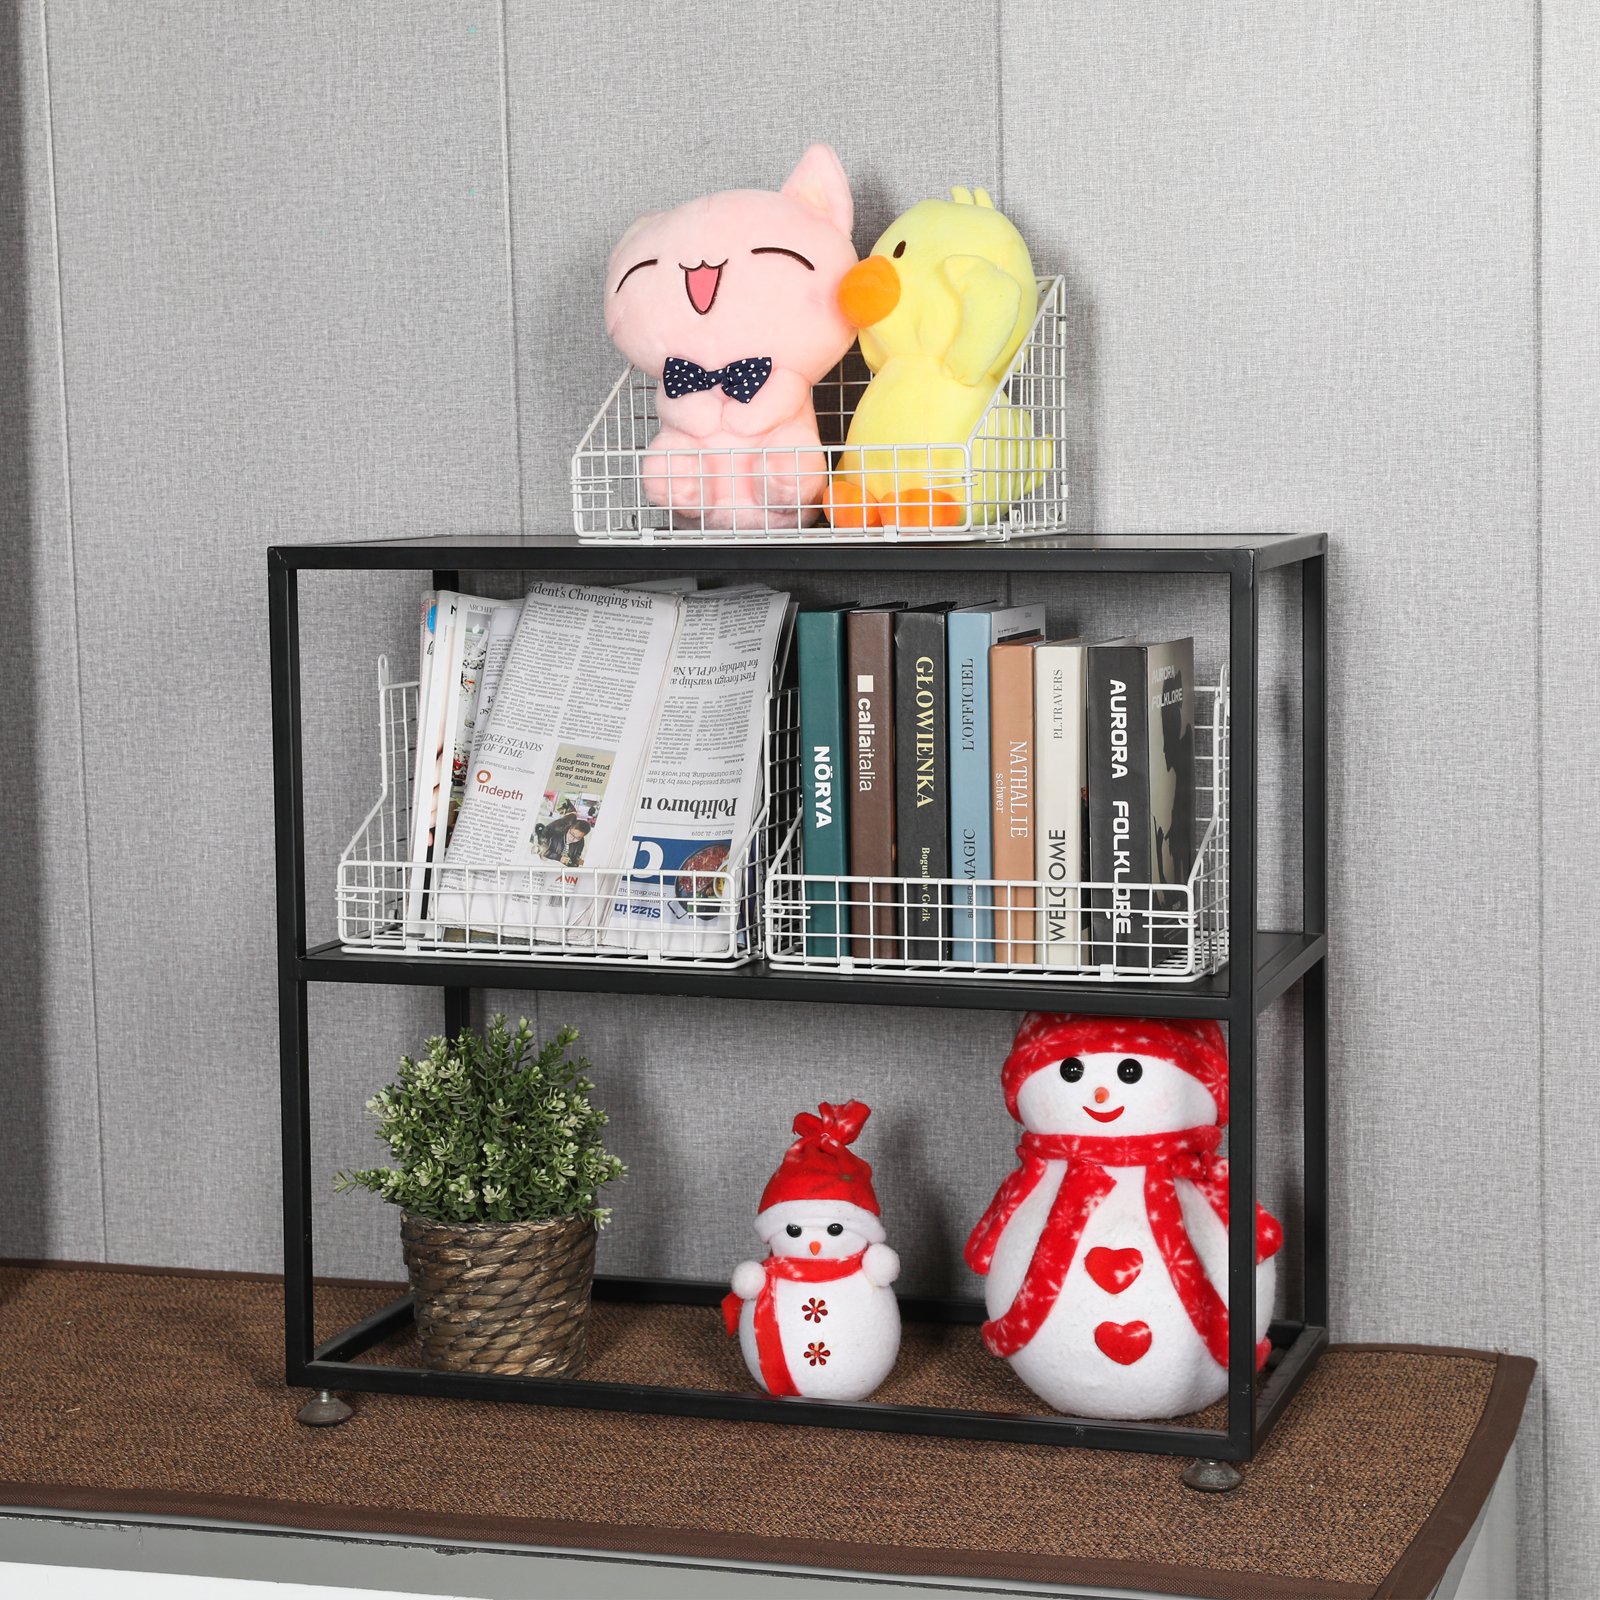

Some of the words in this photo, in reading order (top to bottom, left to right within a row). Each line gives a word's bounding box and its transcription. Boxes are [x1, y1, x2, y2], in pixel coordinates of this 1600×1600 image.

[568, 588, 630, 608] Chongqing
[631, 596, 653, 609] visit
[688, 667, 706, 676] PLA
[706, 666, 717, 676] of
[717, 661, 747, 674] birthday
[747, 659, 758, 669] for
[678, 676, 713, 688] warship
[714, 674, 739, 686] foreign
[740, 671, 756, 681] First
[1151, 665, 1176, 684] AURORA
[962, 658, 975, 751] L'OFFICIEL
[1151, 690, 1183, 710] FOLKLORE
[916, 656, 935, 809] GŁOWIENKA
[1109, 679, 1127, 779] AURORA
[485, 744, 497, 752] OF
[498, 746, 524, 759] TIME
[504, 735, 544, 752] STANDS
[858, 698, 874, 792] caliaitalia
[484, 761, 506, 770] meaning
[514, 767, 536, 775] Chinese
[557, 757, 591, 768] Adoption
[591, 762, 611, 770] trend
[555, 771, 573, 780] stray
[574, 774, 603, 784] animals
[667, 777, 676, 785] by
[478, 784, 523, 801] indepth
[813, 746, 832, 829] NÖRYA
[995, 773, 1004, 814] schwer
[657, 796, 738, 820] Politburo
[962, 828, 978, 882] MAGIC
[1112, 800, 1132, 935] FOLKLORE
[1048, 830, 1066, 942] WELCOME
